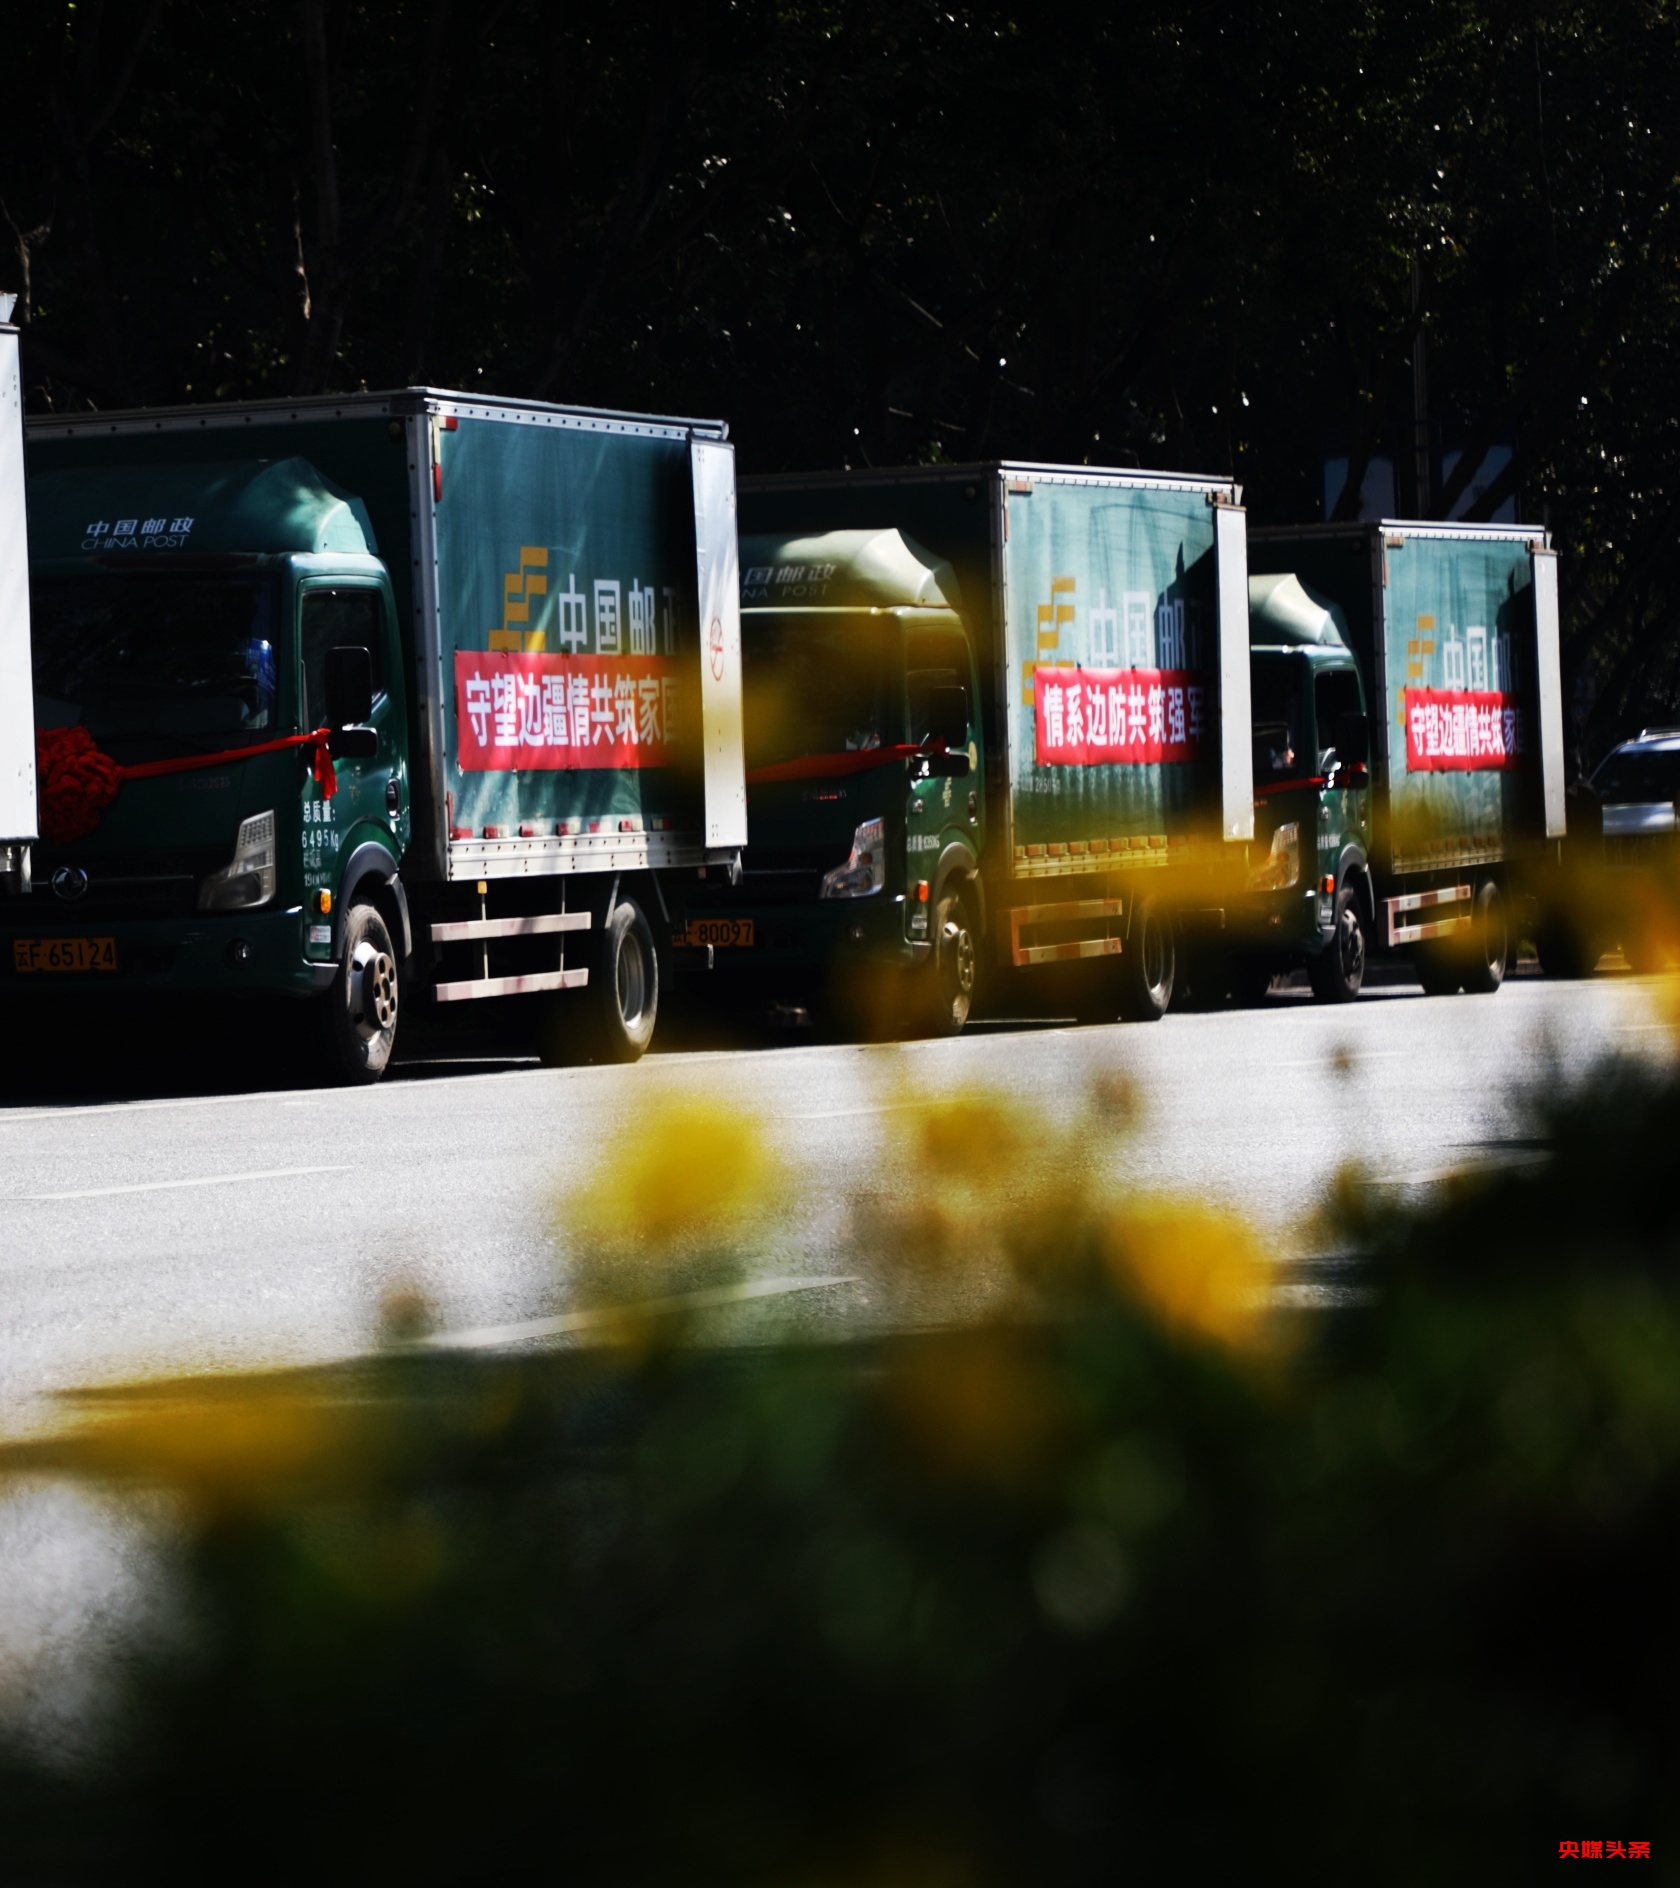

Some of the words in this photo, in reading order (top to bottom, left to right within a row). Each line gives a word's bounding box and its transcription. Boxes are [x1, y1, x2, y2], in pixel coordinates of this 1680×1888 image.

[85, 516, 195, 538] 中国邮政
[80, 535, 138, 551] CHINA
[143, 533, 189, 549] POST
[739, 563, 837, 586] 国邮政
[1443, 624, 1515, 693] 中国邮
[1042, 683, 1206, 748] 情系边防共筑强军
